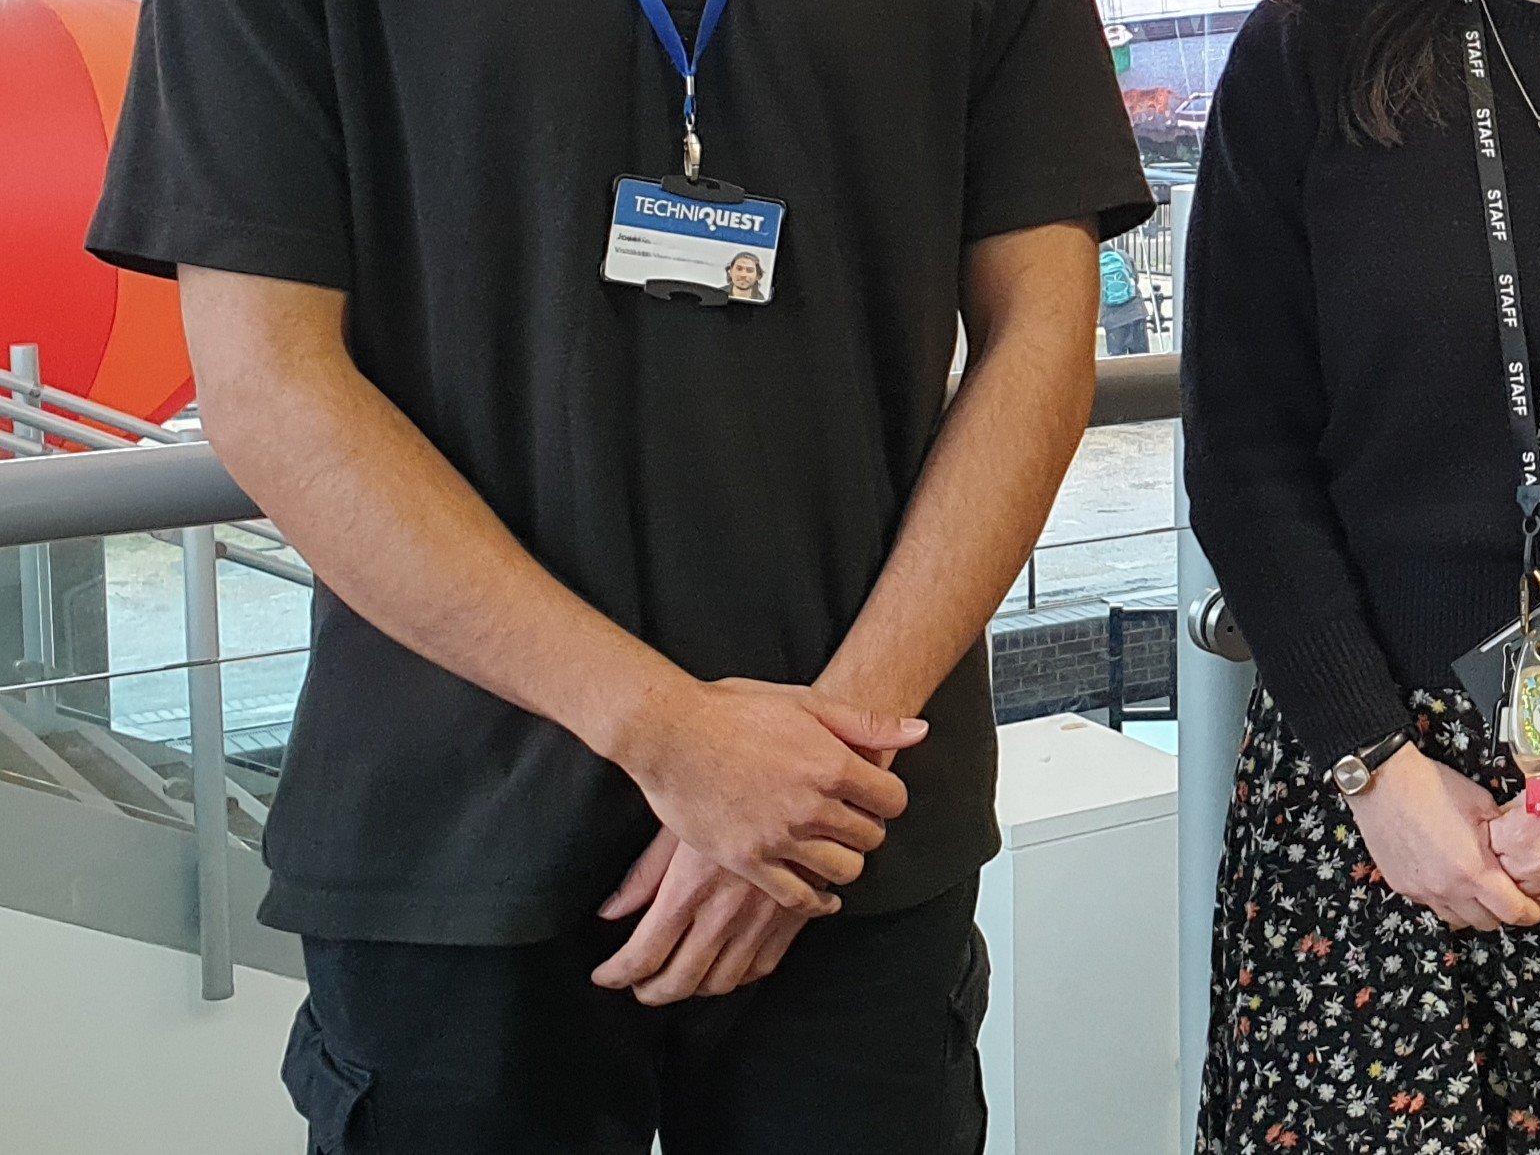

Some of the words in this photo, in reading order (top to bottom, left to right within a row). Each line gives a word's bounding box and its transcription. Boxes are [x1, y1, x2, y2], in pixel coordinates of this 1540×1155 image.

[635, 195, 765, 232] TECHNIQUEST
[1465, 30, 1485, 79] STAFF
[1476, 108, 1496, 158] STAFF
[1487, 189, 1508, 241] STAFF
[1499, 274, 1518, 328] STAFF
[1509, 361, 1528, 417] STAFF
[1522, 451, 1538, 486] STA
